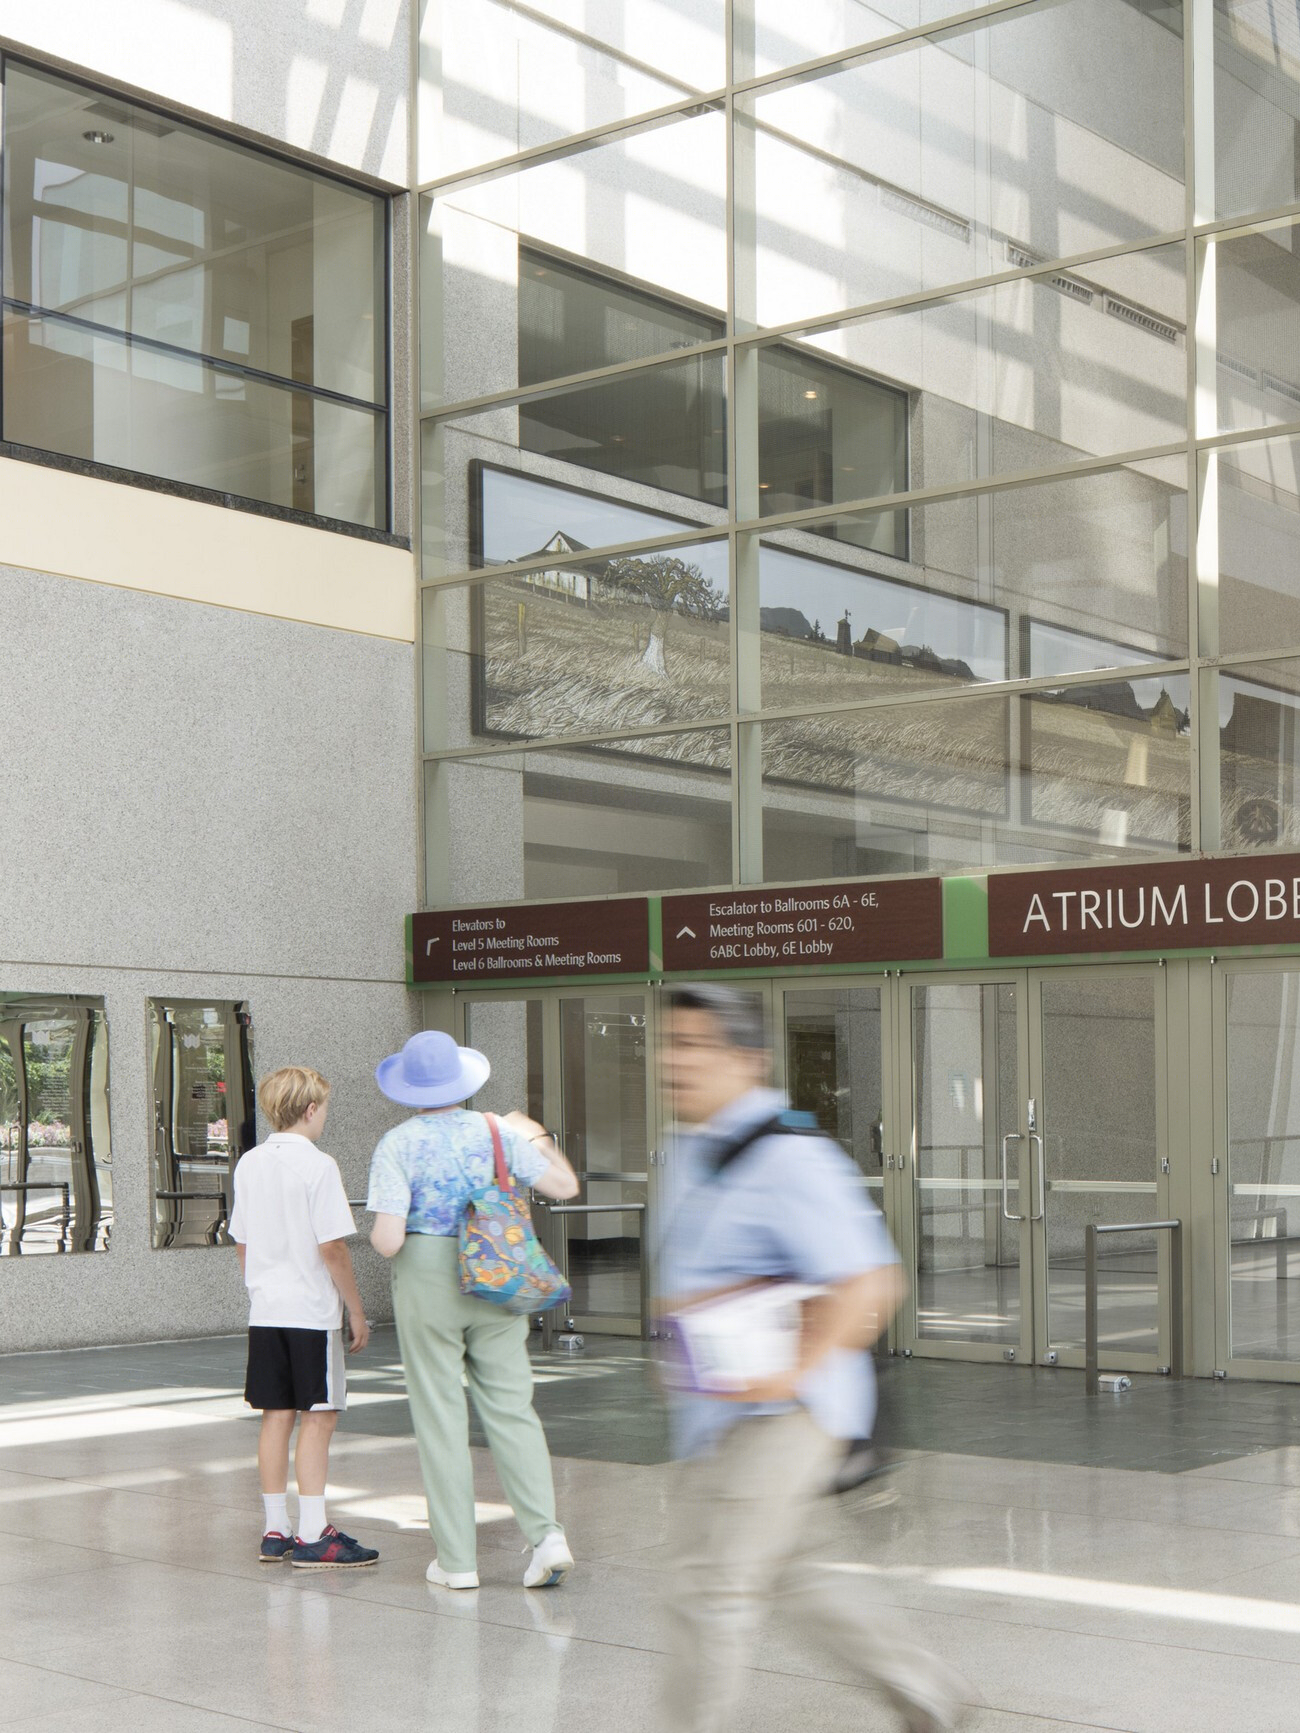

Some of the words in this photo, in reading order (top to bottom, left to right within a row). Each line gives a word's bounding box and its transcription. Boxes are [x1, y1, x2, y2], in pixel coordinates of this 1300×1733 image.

[709, 901, 759, 917] Escalator
[760, 901, 772, 914] to
[774, 897, 830, 913] Ballrooms
[832, 894, 851, 909] 6A
[860, 892, 879, 908] 6E,
[1021, 884, 1188, 933] ATRIUM
[452, 919, 494, 932] Elevators
[495, 918, 506, 930] to
[709, 923, 754, 938] Meeting
[756, 921, 795, 935] Rooms
[797, 918, 818, 933] 601
[828, 916, 855, 932] 620,
[452, 939, 476, 951] Level
[478, 938, 484, 950] 5
[486, 936, 525, 950] Meeting
[526, 935, 560, 947] Rooms
[710, 943, 741, 959] 6ABC
[744, 942, 780, 959] Lobby,
[782, 941, 797, 955] 6E
[799, 939, 834, 956] Lobby
[453, 958, 477, 971] Level
[478, 957, 485, 970] 6
[487, 956, 533, 969] Ballrooms
[534, 955, 544, 967] &
[545, 953, 586, 968] Meeting
[587, 952, 622, 964] Rooms
